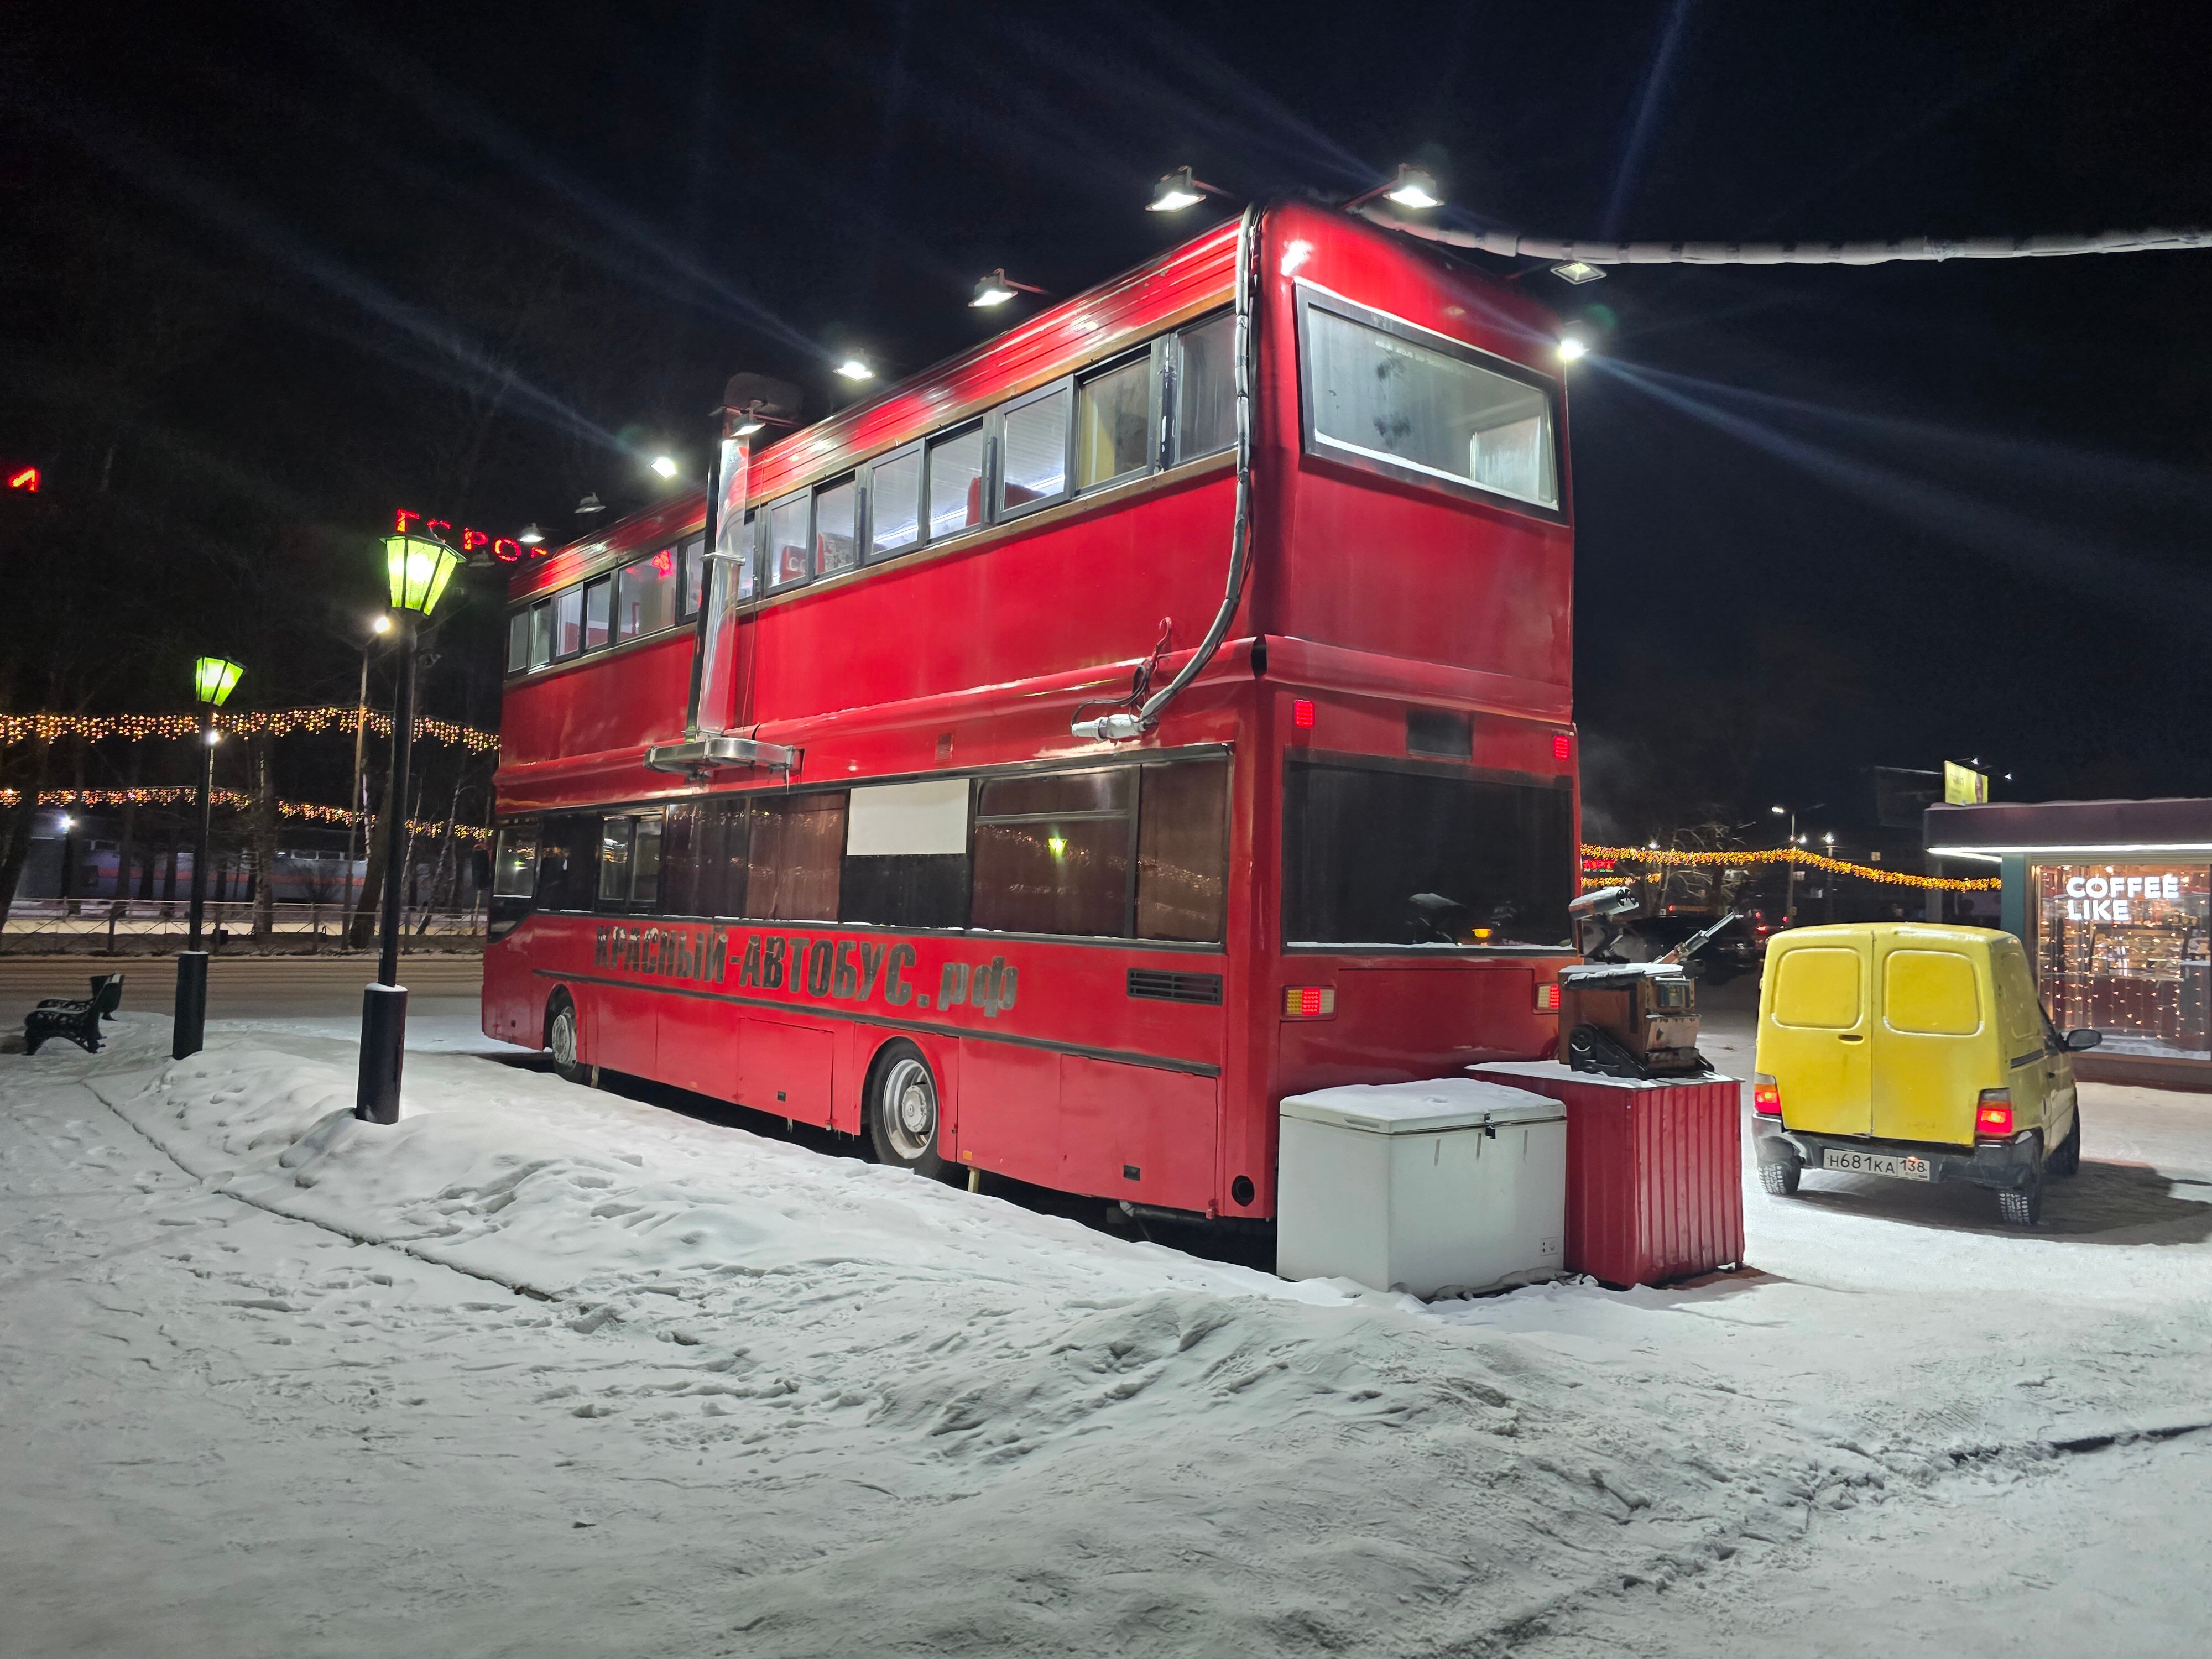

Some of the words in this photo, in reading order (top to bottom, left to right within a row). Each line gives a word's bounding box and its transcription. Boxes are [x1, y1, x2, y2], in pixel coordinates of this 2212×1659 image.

[2066, 876, 2180, 899] COFFEE
[2067, 899, 2130, 921] LIKE
[1829, 1153, 1895, 1174] Н681КА
[1899, 1159, 1927, 1173] 138
